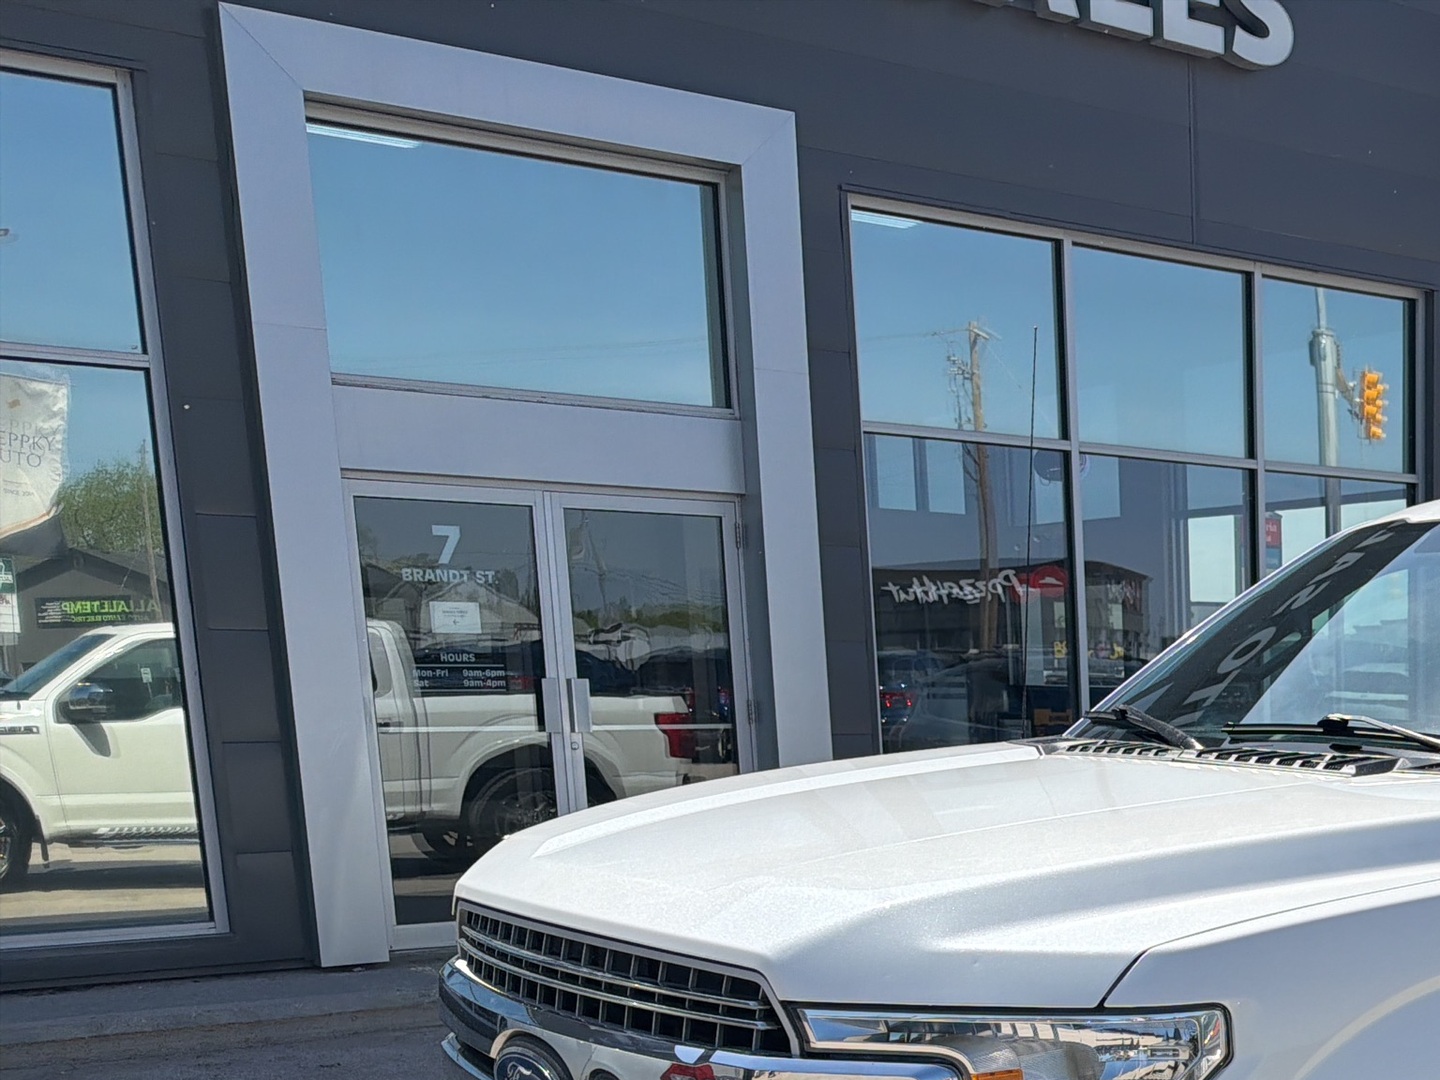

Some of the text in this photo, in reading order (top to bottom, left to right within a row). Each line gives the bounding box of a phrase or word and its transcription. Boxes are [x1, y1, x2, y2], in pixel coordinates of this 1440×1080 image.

[431, 525, 461, 564] 7
[401, 567, 499, 585] BRANDT ST.
[440, 653, 476, 662] HOURS
[462, 669, 505, 678] 9am-6pm
[463, 679, 506, 688] 9am-4pm
